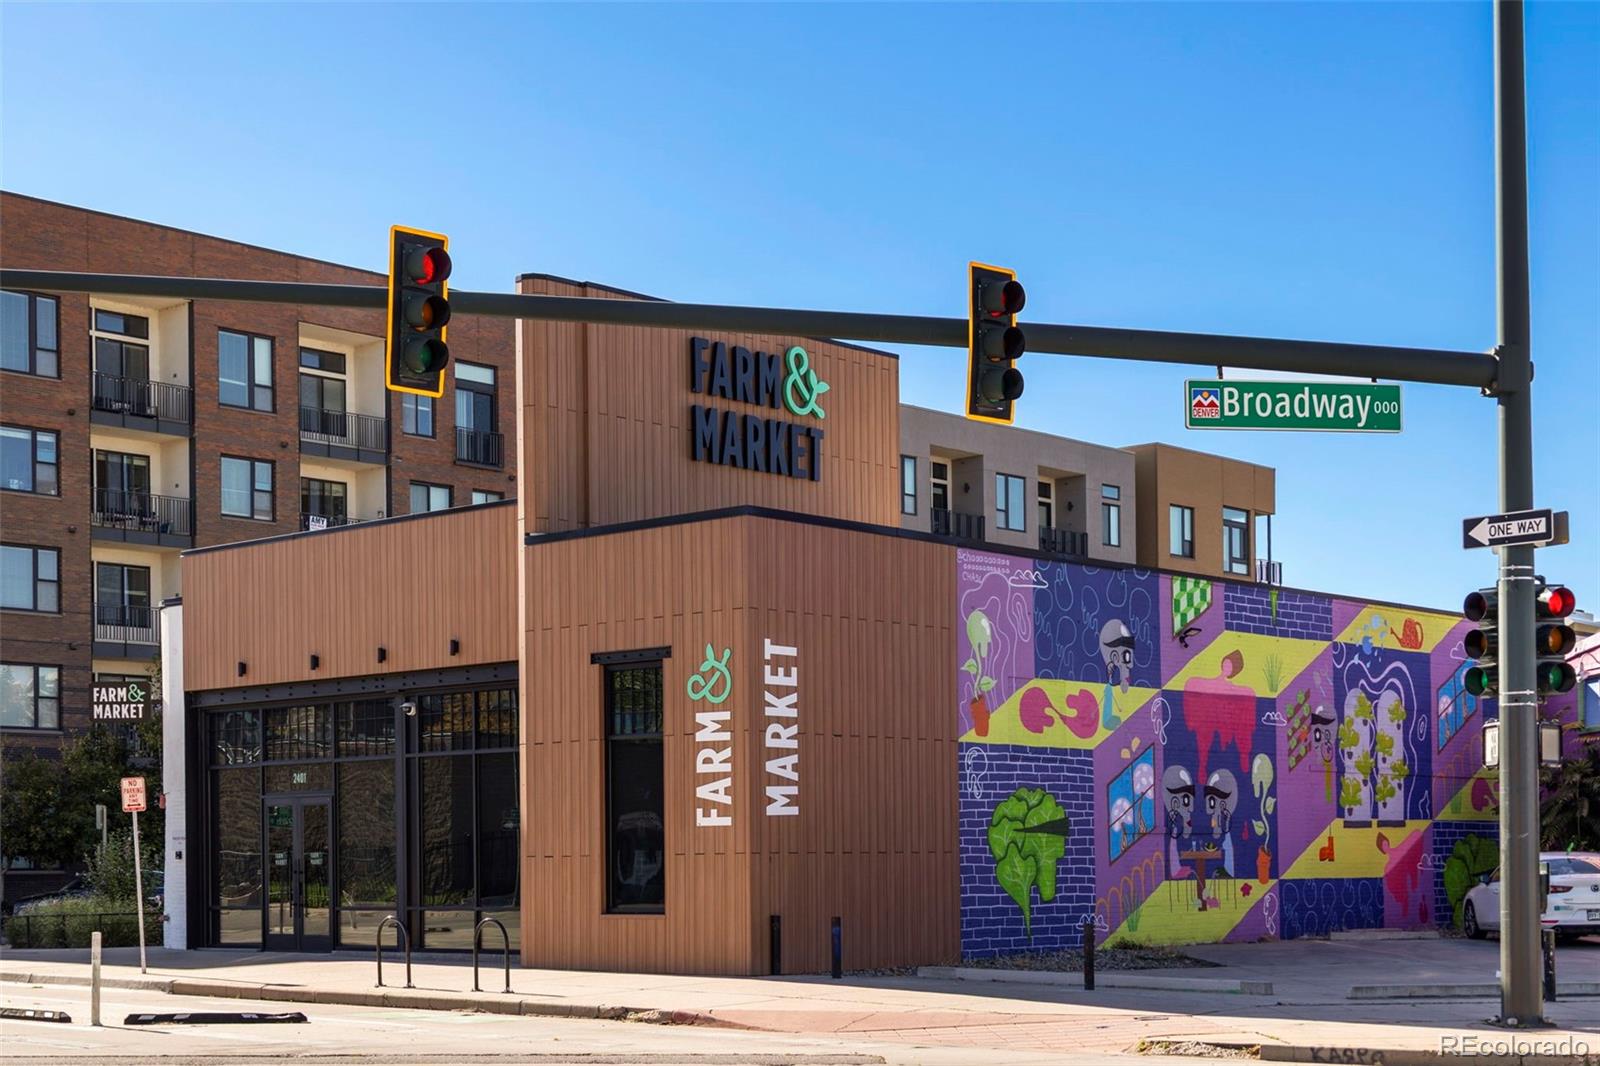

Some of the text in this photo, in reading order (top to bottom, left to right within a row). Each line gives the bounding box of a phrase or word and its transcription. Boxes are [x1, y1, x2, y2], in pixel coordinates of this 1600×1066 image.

[690, 336, 781, 410] FARM
[1193, 407, 1219, 418] DENVER
[1223, 386, 1399, 428] Broadway 000
[690, 404, 825, 482] MARKET
[1488, 519, 1542, 537] ONE WAY
[93, 687, 127, 702] FARM
[93, 703, 144, 719] MARKET
[764, 638, 799, 816] MARKET
[695, 710, 732, 827] FARM
